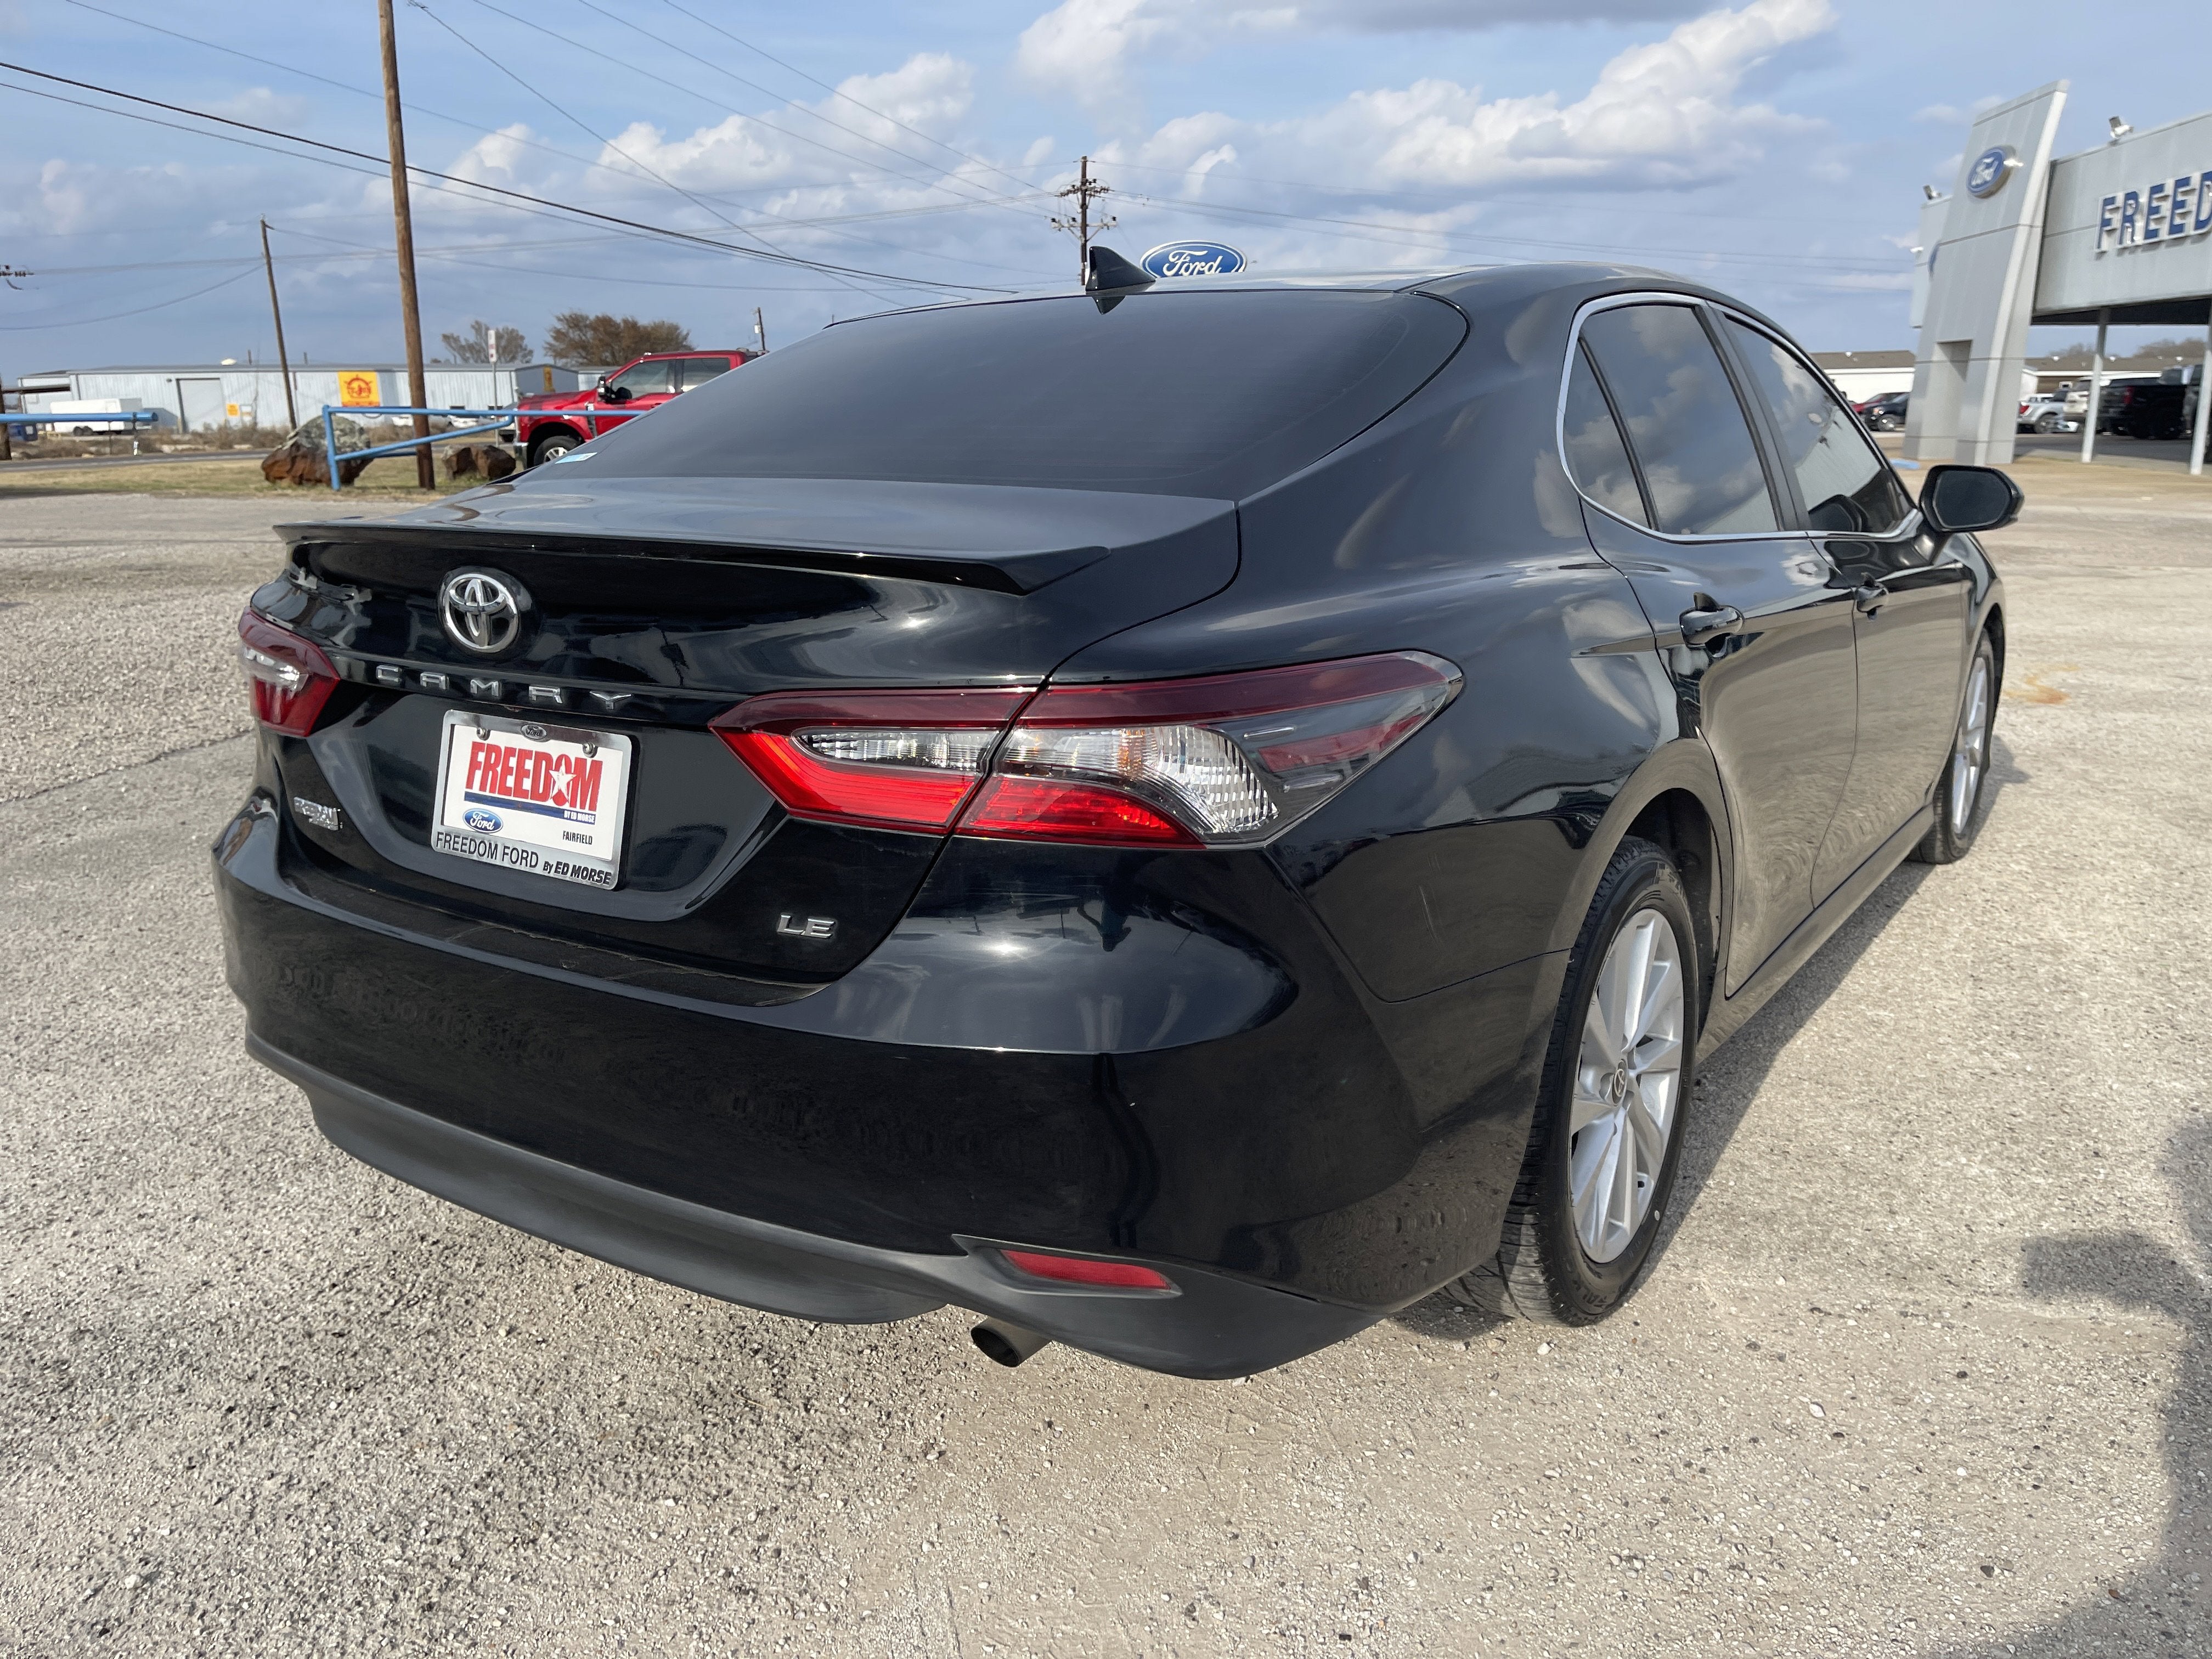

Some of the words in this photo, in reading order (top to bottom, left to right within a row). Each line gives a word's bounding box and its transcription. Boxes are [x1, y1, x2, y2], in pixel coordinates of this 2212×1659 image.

[1163, 250, 1223, 276] Ford
[376, 664, 632, 710] CAMRY
[465, 741, 603, 812] FREEDOM
[470, 810, 495, 831] Ford
[564, 810, 571, 819] BY
[571, 811, 577, 820] ED
[577, 812, 595, 823] MORSE
[562, 830, 593, 845] FAIRFIELD
[436, 831, 498, 860] FREEDOM
[501, 845, 539, 868] FORD
[554, 861, 570, 876] ED
[570, 864, 612, 885] MORSE
[777, 914, 836, 939] LE
